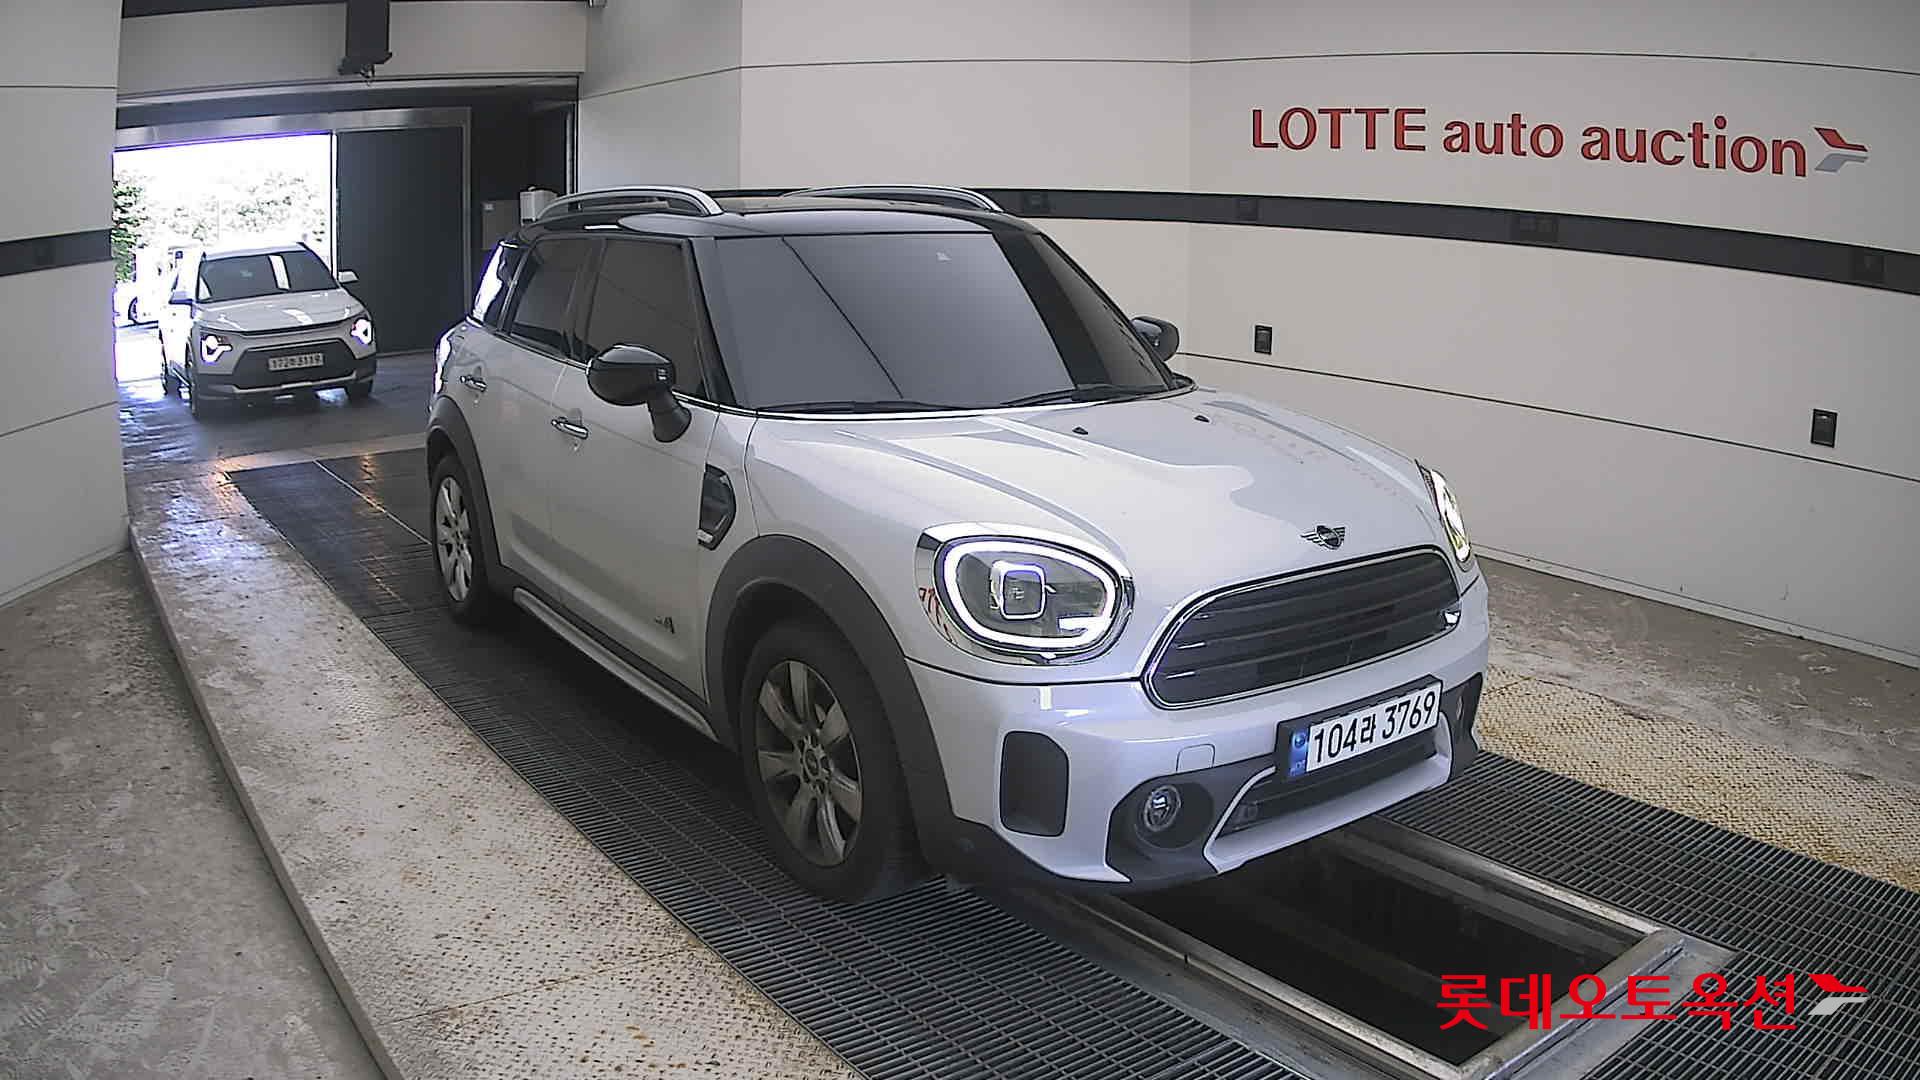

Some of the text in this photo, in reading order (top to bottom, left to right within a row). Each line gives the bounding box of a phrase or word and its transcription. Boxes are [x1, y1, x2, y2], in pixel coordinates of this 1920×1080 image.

[1252, 107, 1807, 178] LOTTE auto auction
[1314, 691, 1436, 763] 104라 3769
